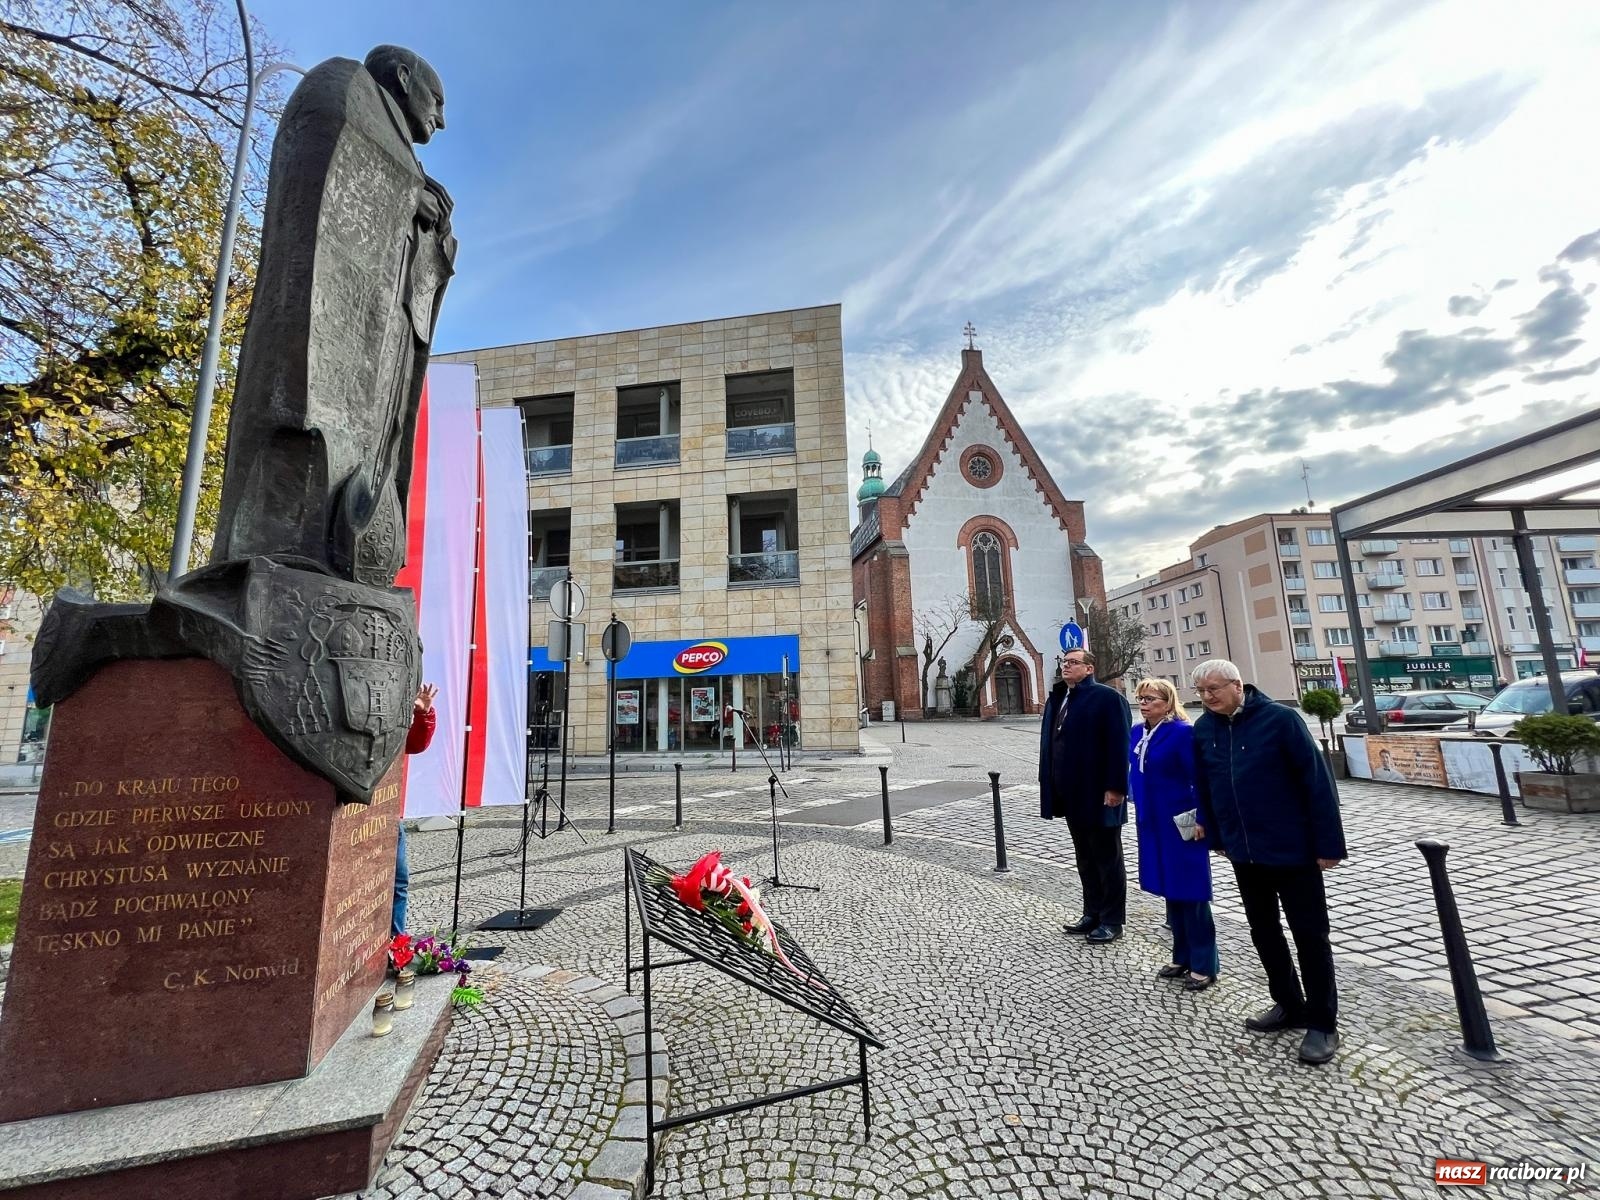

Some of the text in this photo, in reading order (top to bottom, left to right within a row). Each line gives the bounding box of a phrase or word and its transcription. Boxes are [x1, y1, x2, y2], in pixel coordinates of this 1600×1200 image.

[681, 651, 720, 663] PEPCO
[1300, 666, 1335, 677] STELL
[1406, 662, 1451, 670] JUBILER
[117, 778, 182, 796] KRAJU
[191, 775, 240, 793] TEGO
[373, 782, 399, 806] FELIKS
[54, 800, 314, 828] GDZIE PIERWSZE UKŁONY
[48, 830, 266, 860] SĄ JAK ODWIECZNE
[44, 856, 290, 889] CHRYSTUSA WYZNANIE
[113, 887, 256, 915] POCHWALONY
[336, 888, 362, 919] BISKUP
[332, 888, 389, 945] WOJSK POLSKICH
[37, 929, 121, 956] TĘSKNO
[136, 925, 163, 944] MI
[163, 957, 300, 992] C. K. Norwid
[319, 956, 361, 1010] EMIGRACJI
